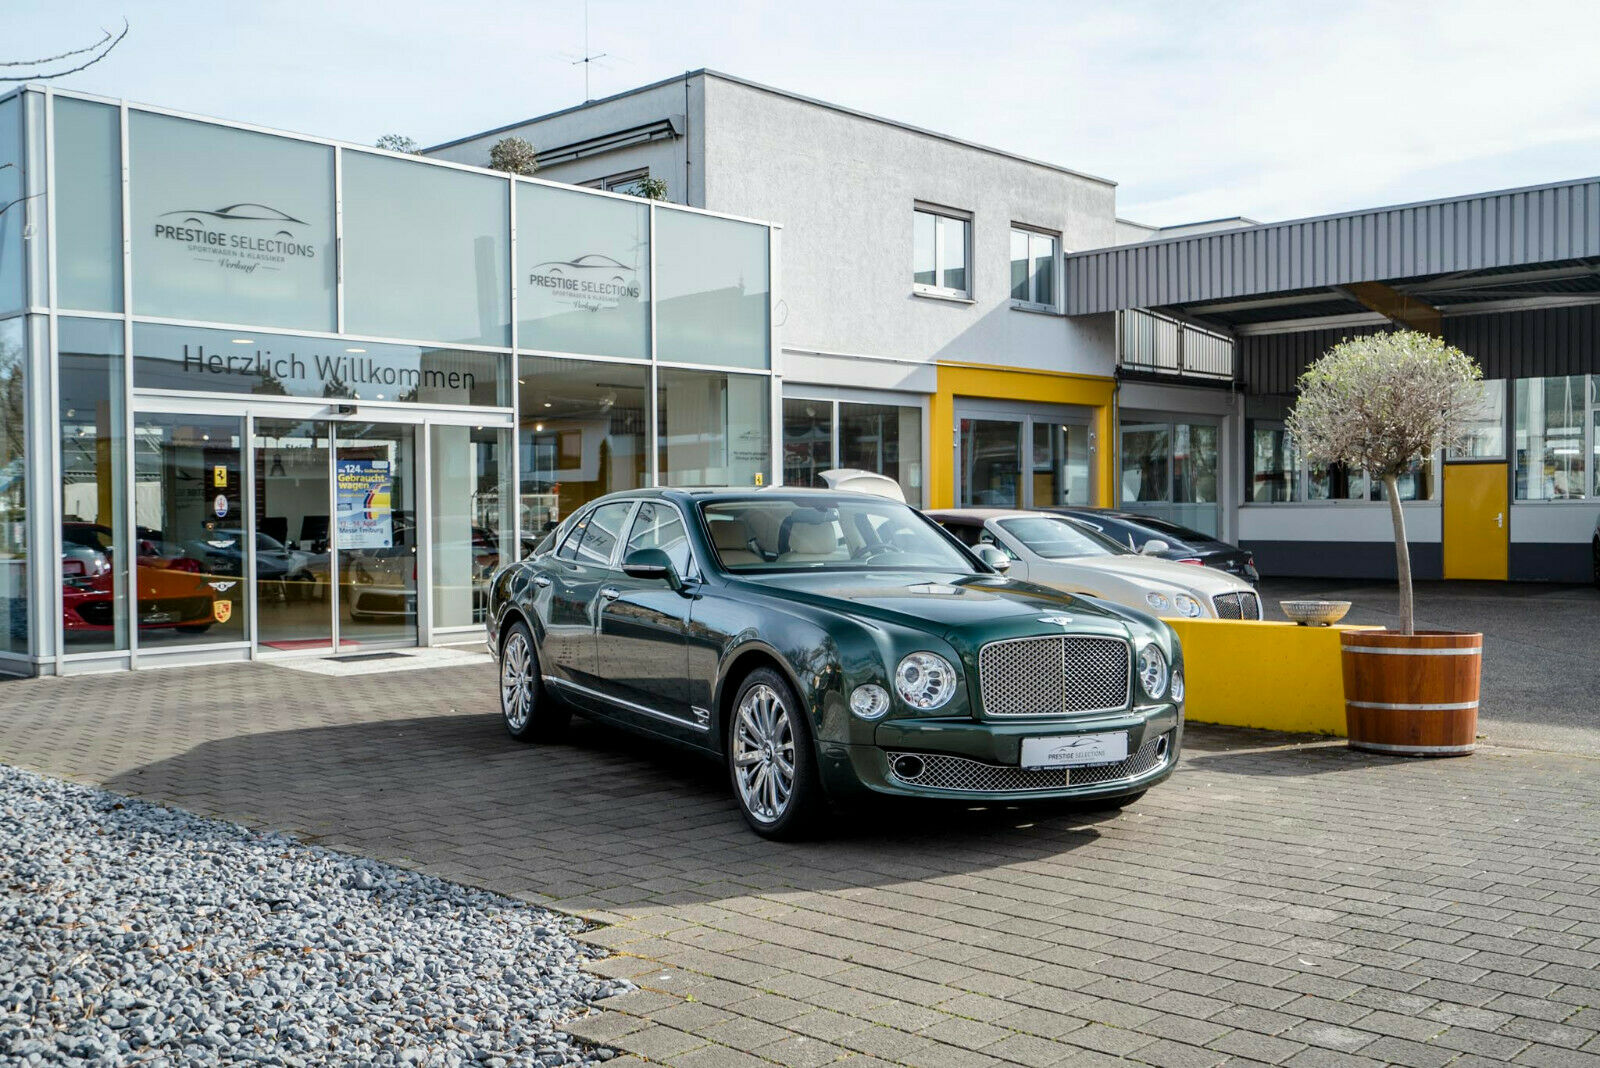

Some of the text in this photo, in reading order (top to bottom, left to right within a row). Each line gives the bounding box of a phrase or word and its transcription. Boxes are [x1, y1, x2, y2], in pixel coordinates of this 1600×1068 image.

[155, 224, 315, 258] PRESTIGE SELECTIONS
[187, 244, 238, 257] SPORTWAGEN
[246, 253, 286, 263] KLASSIKER
[529, 274, 640, 298] PRESTIGE SELECTIONS
[183, 344, 476, 390] Herzlich Willkommen
[344, 464, 364, 473] 124.
[337, 473, 388, 482] Gebraucht-
[338, 482, 370, 492] wagen
[1048, 752, 1074, 760] PRESTIGE
[1075, 750, 1105, 759] SELECTIONS
